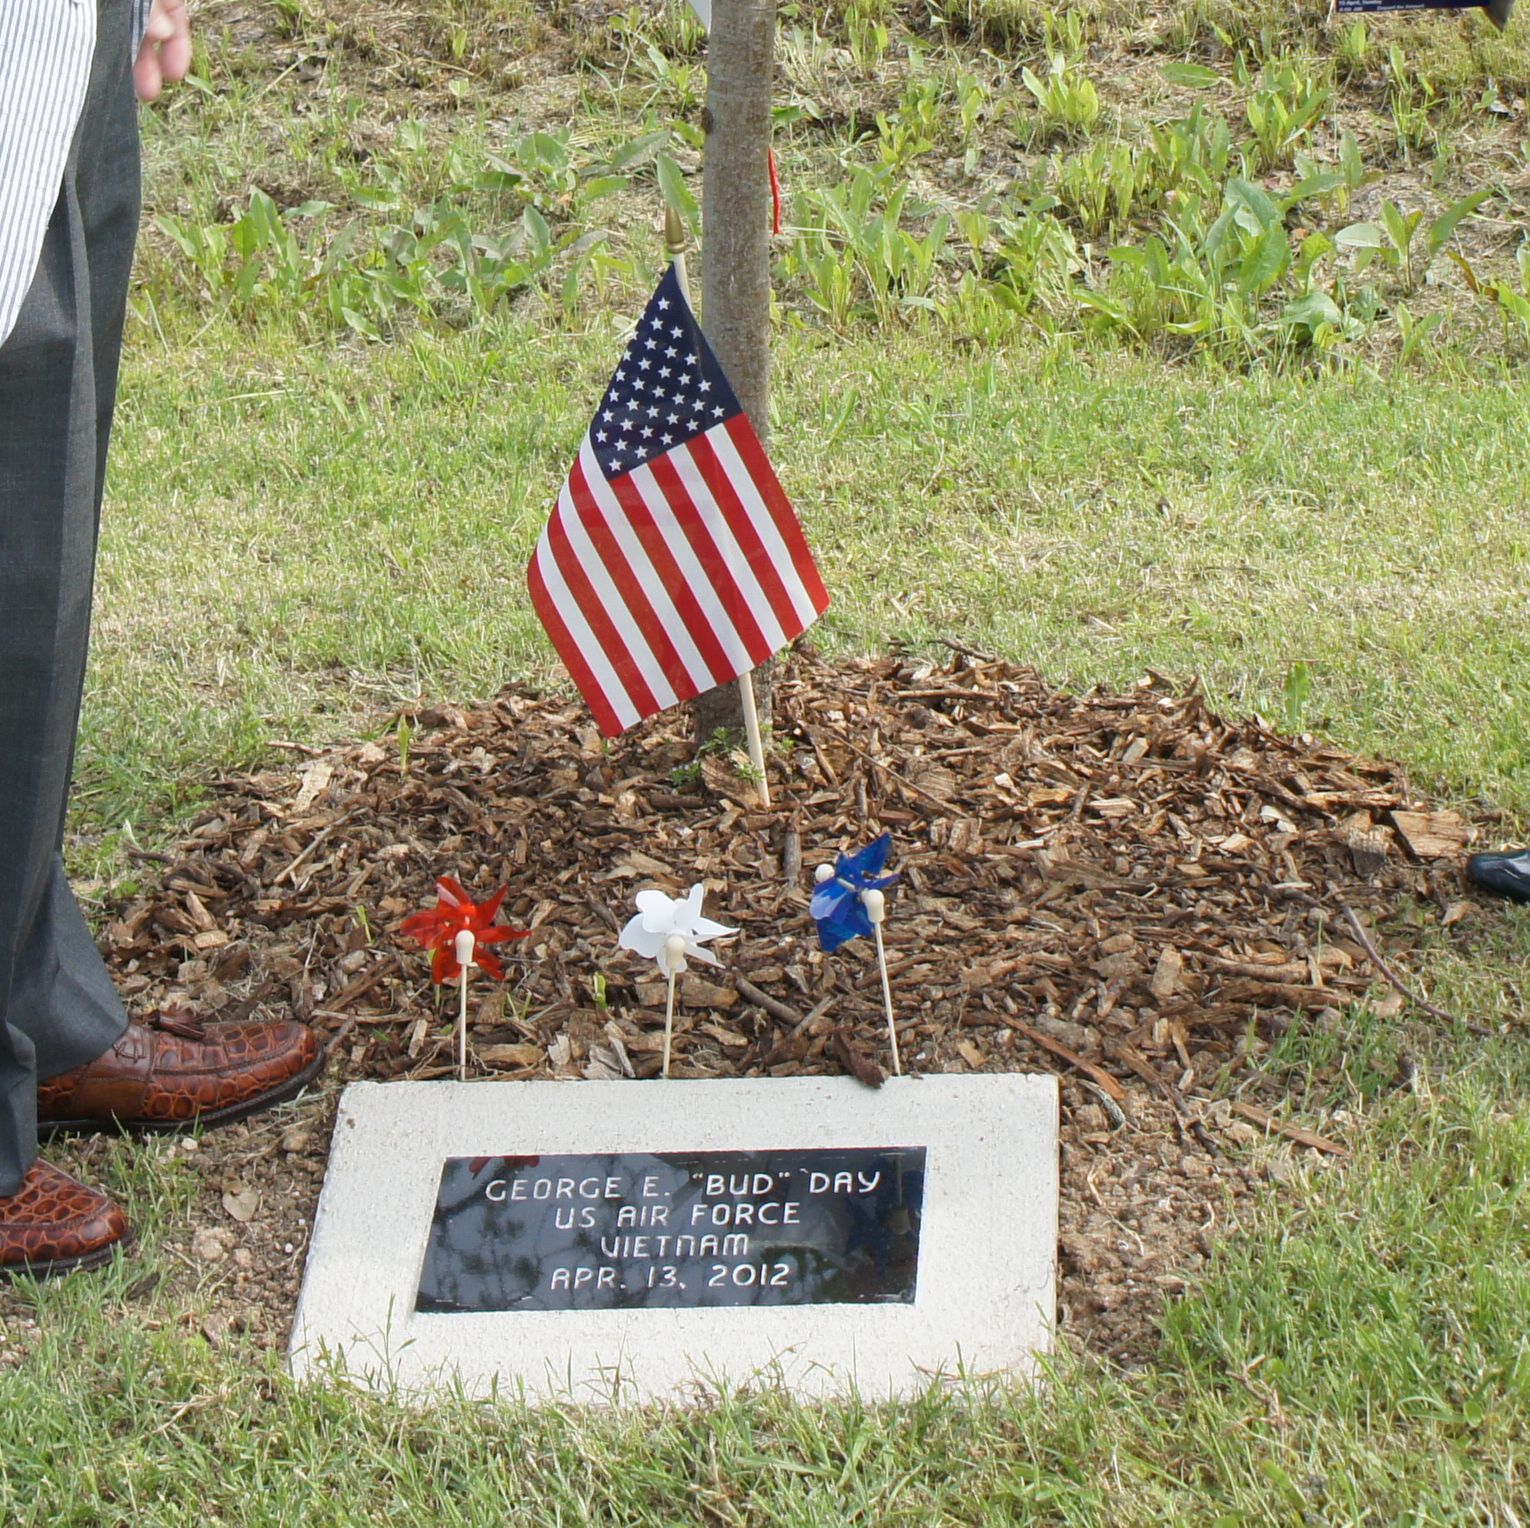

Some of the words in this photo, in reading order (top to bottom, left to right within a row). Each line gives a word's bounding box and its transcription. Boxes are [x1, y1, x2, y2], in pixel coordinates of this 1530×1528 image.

[485, 1177, 622, 1202] GEORGE
[643, 1176, 670, 1197] E.
[692, 1172, 790, 1196] "BUD"
[809, 1171, 881, 1193] DAY
[555, 1207, 596, 1229] US
[617, 1205, 669, 1227] AIR
[691, 1202, 800, 1226] FORCE
[601, 1233, 749, 1258] VIETNAM
[551, 1268, 626, 1290] APR.
[709, 1263, 789, 1287] 2012
